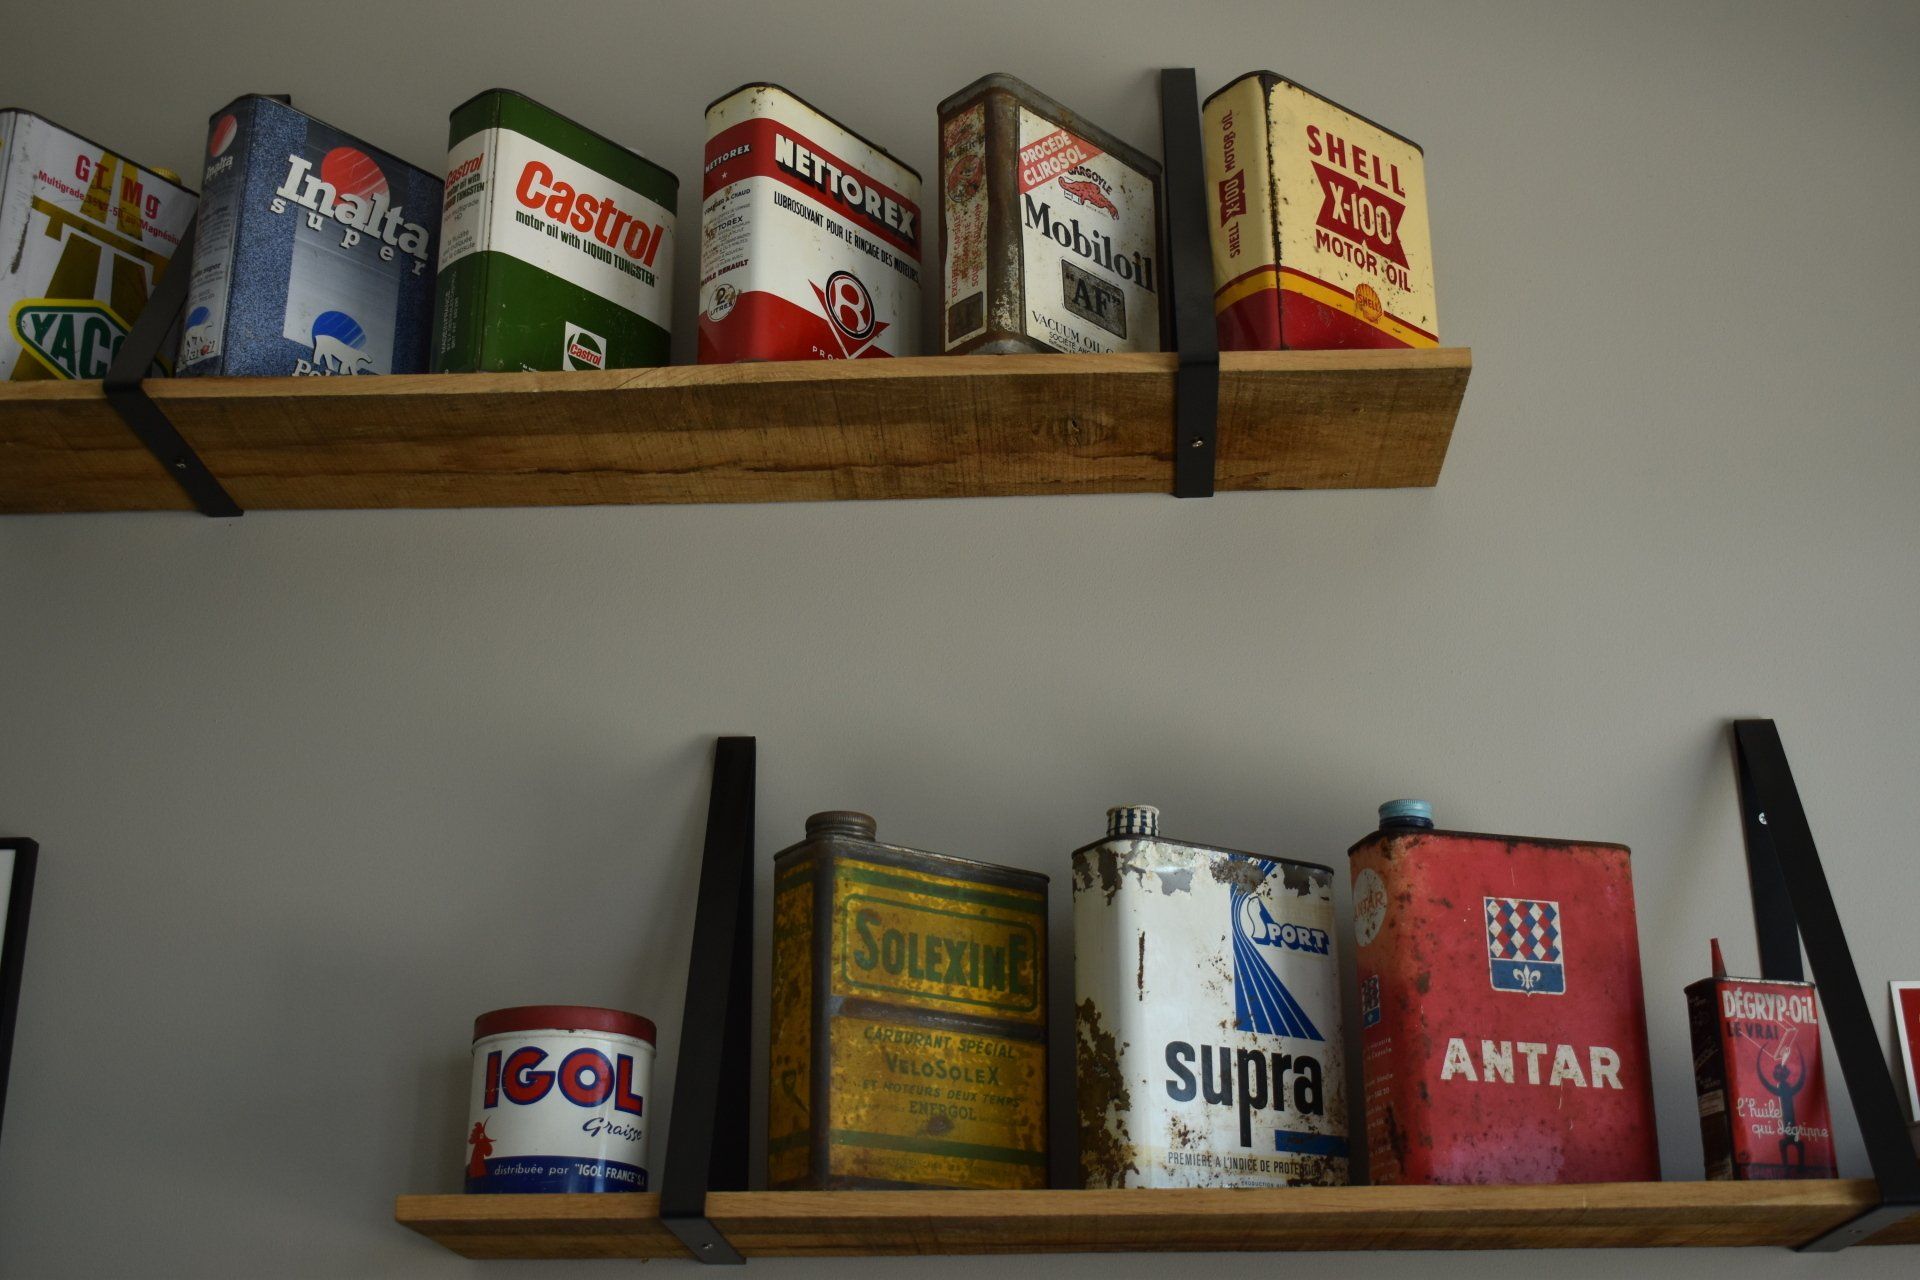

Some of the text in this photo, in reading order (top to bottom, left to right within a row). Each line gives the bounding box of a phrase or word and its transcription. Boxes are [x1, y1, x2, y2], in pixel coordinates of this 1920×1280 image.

[705, 144, 751, 174] NETTOREX
[1024, 145, 1088, 186] CLIROSOL
[1221, 109, 1235, 173] MOTOR OIL
[1306, 124, 1406, 199] SHELL
[38, 169, 84, 200] Multigrade
[75, 154, 109, 188] GT
[123, 176, 160, 219] Mg
[444, 153, 484, 190] Castrol
[775, 133, 915, 239] NETTOREX
[276, 154, 430, 262] Inalta
[516, 160, 664, 268] Castrol
[774, 191, 823, 228] LUBROSOLVANT
[827, 219, 843, 239] POUR
[845, 228, 853, 244] LE
[881, 250, 893, 267] DES
[1328, 180, 1393, 246] X-100
[515, 210, 656, 288] motor oil with LIQUID TUNGSTEN
[1024, 192, 1156, 294] Mobiloil
[1228, 221, 1241, 259] SHELL
[1316, 229, 1411, 293] MOTOR OIL
[1032, 310, 1080, 343] VACUUM
[570, 343, 602, 366] Castrol
[1247, 896, 1329, 954] SPORT
[854, 908, 1027, 995] SOLEXINE
[864, 1026, 951, 1049] CARBURANT
[1745, 1023, 1779, 1040] VRAI
[484, 1046, 643, 1117] IGOL
[1440, 1038, 1624, 1090] ANTAR
[862, 1079, 1023, 1109] ET MOTEURS DEUX TEMPS
[1165, 1040, 1324, 1148] supra
[1736, 1097, 1782, 1118] l'huile
[582, 1117, 643, 1142] Graisse
[1751, 1120, 1775, 1139] qui
[494, 1162, 543, 1176] distribuée
[549, 1165, 570, 1177] par
[1223, 1157, 1257, 1172] L'INDICE
[1260, 1160, 1270, 1172] DE
